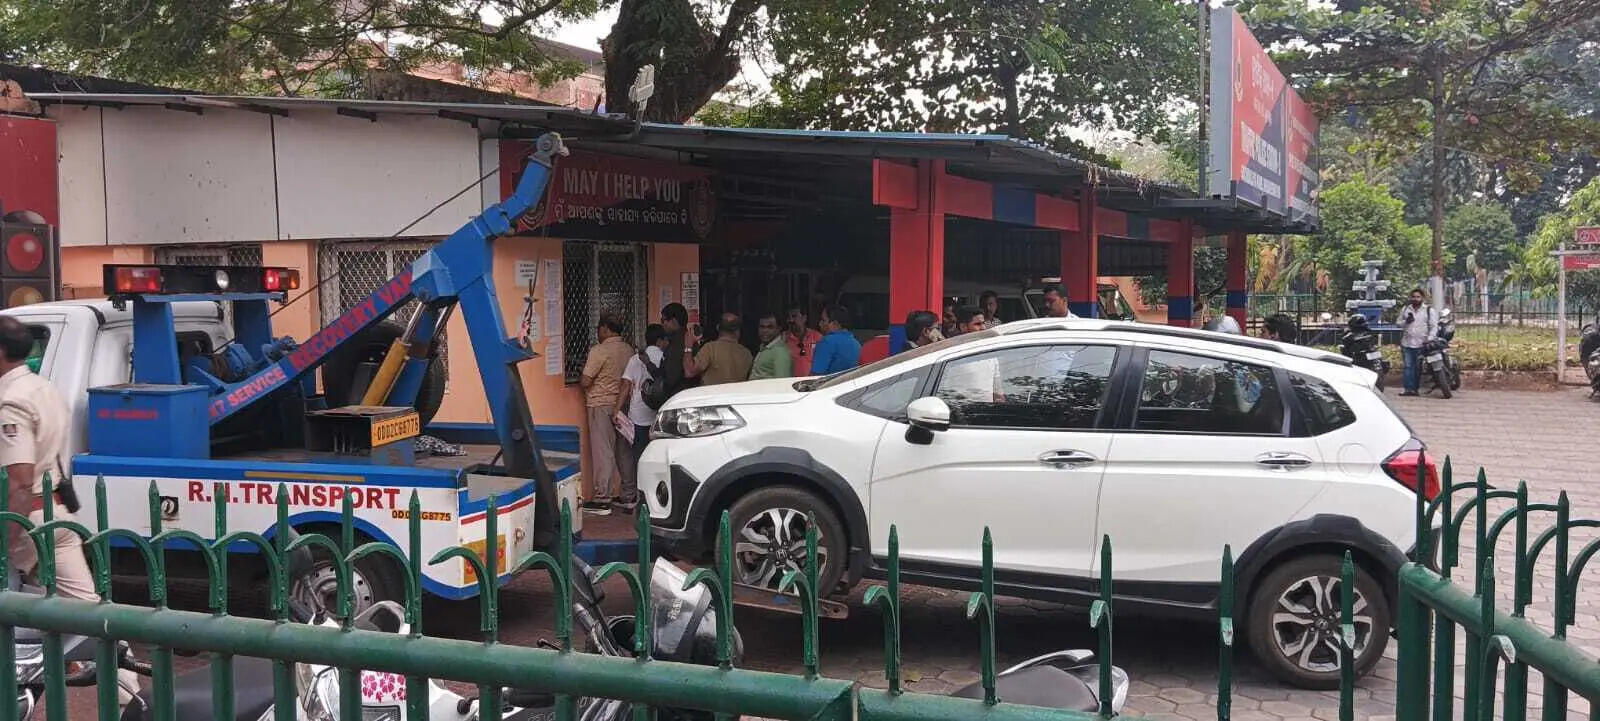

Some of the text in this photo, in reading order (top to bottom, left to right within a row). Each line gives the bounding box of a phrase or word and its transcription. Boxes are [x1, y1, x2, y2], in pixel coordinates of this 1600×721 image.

[563, 168, 681, 203] MAY I HELP YOU
[227, 366, 288, 408] SERVICE
[288, 301, 379, 372] RECOVERY
